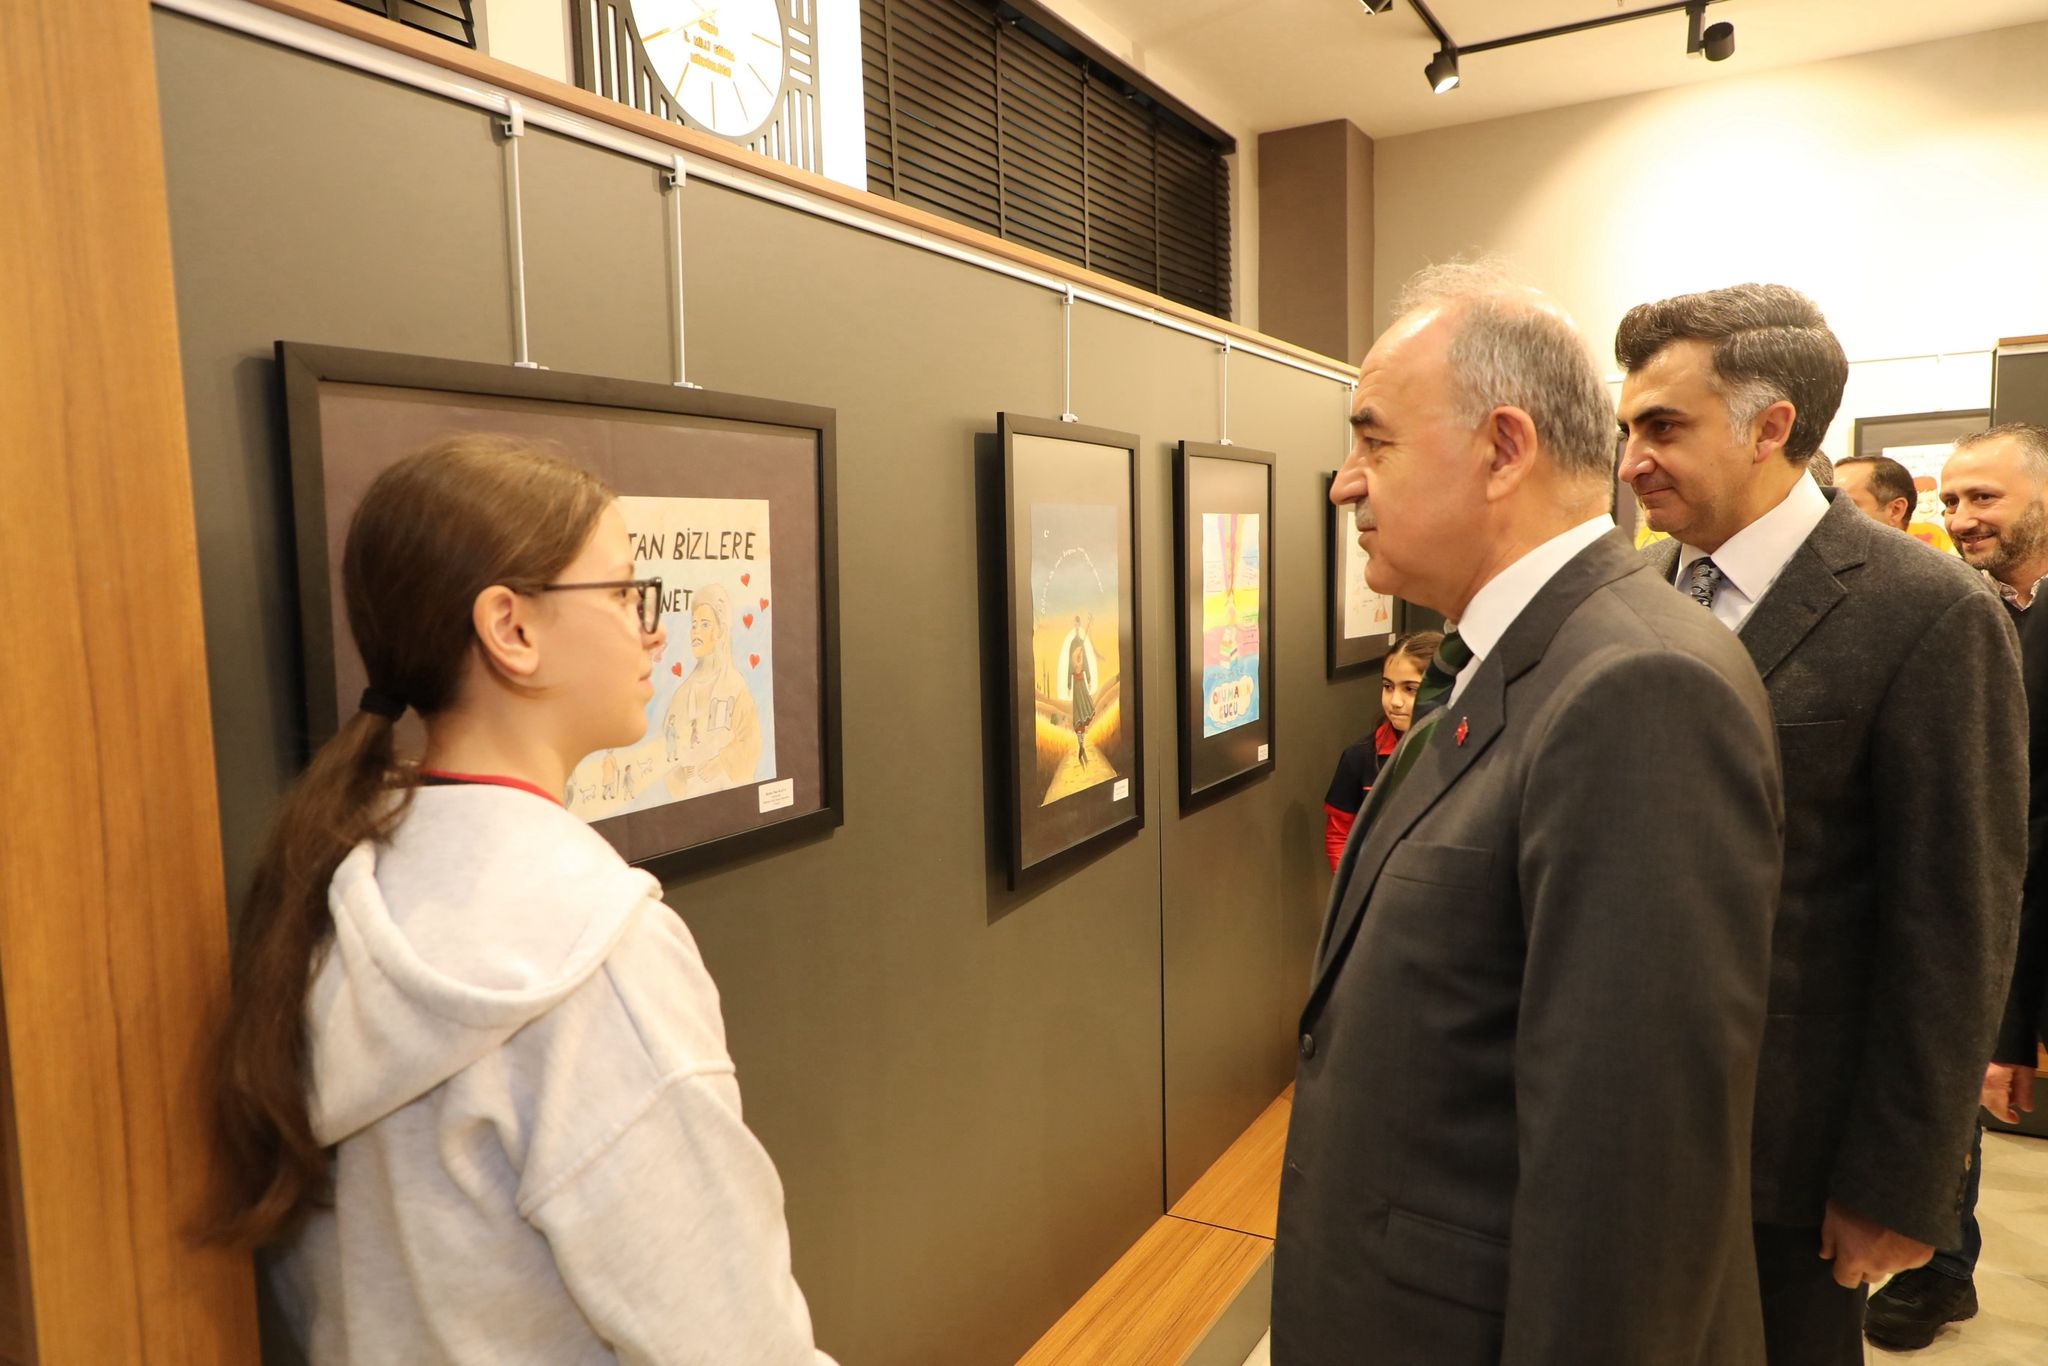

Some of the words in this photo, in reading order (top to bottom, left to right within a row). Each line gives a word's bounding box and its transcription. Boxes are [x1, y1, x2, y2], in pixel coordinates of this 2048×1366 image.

[628, 532, 664, 560] TAN
[673, 528, 756, 560] BİZLERE
[660, 588, 693, 613] NET
